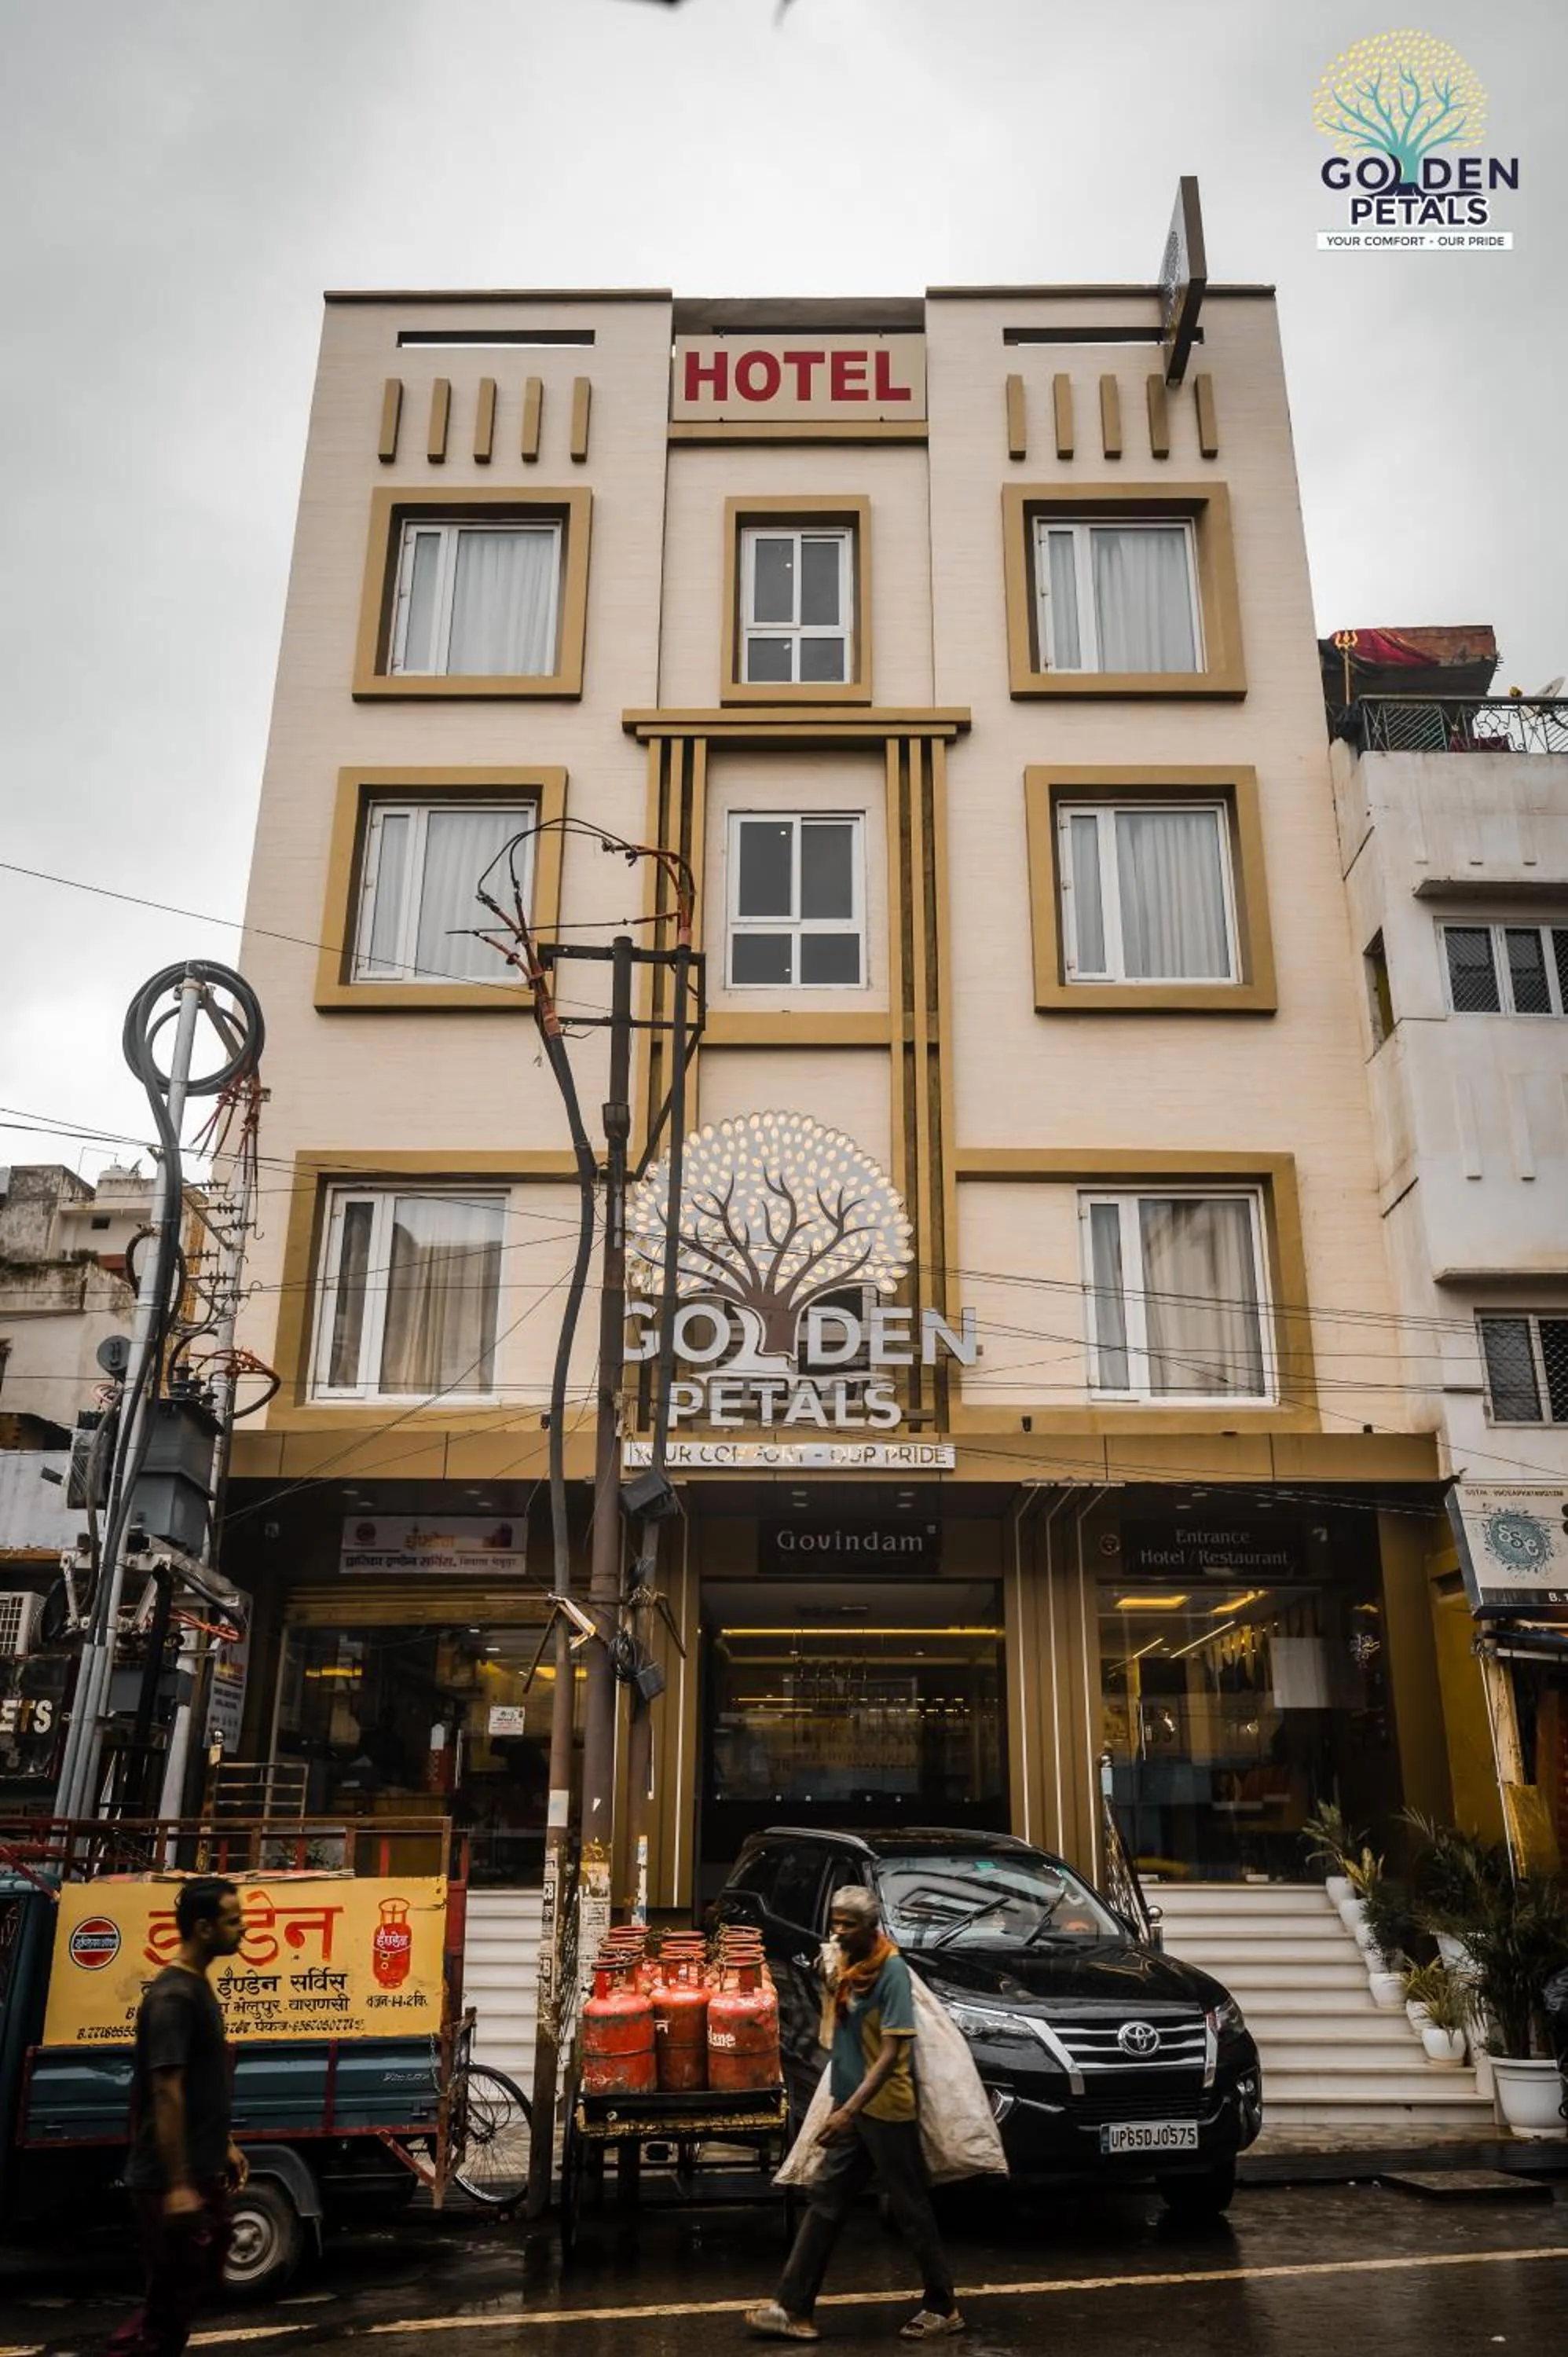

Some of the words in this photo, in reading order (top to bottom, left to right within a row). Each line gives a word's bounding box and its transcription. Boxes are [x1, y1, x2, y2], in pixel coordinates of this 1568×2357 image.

[683, 350, 912, 402] HOTEL
[667, 1380, 903, 1429] PETALS
[634, 1446, 691, 1464] YUR
[885, 1446, 947, 1464] PRIDE
[776, 1530, 923, 1552] Govindam
[1175, 1530, 1251, 1545] Entrance
[1141, 1550, 1185, 1566] Hotel
[1199, 1551, 1288, 1566] Restaurant
[289, 1967, 348, 1993] सर्विस
